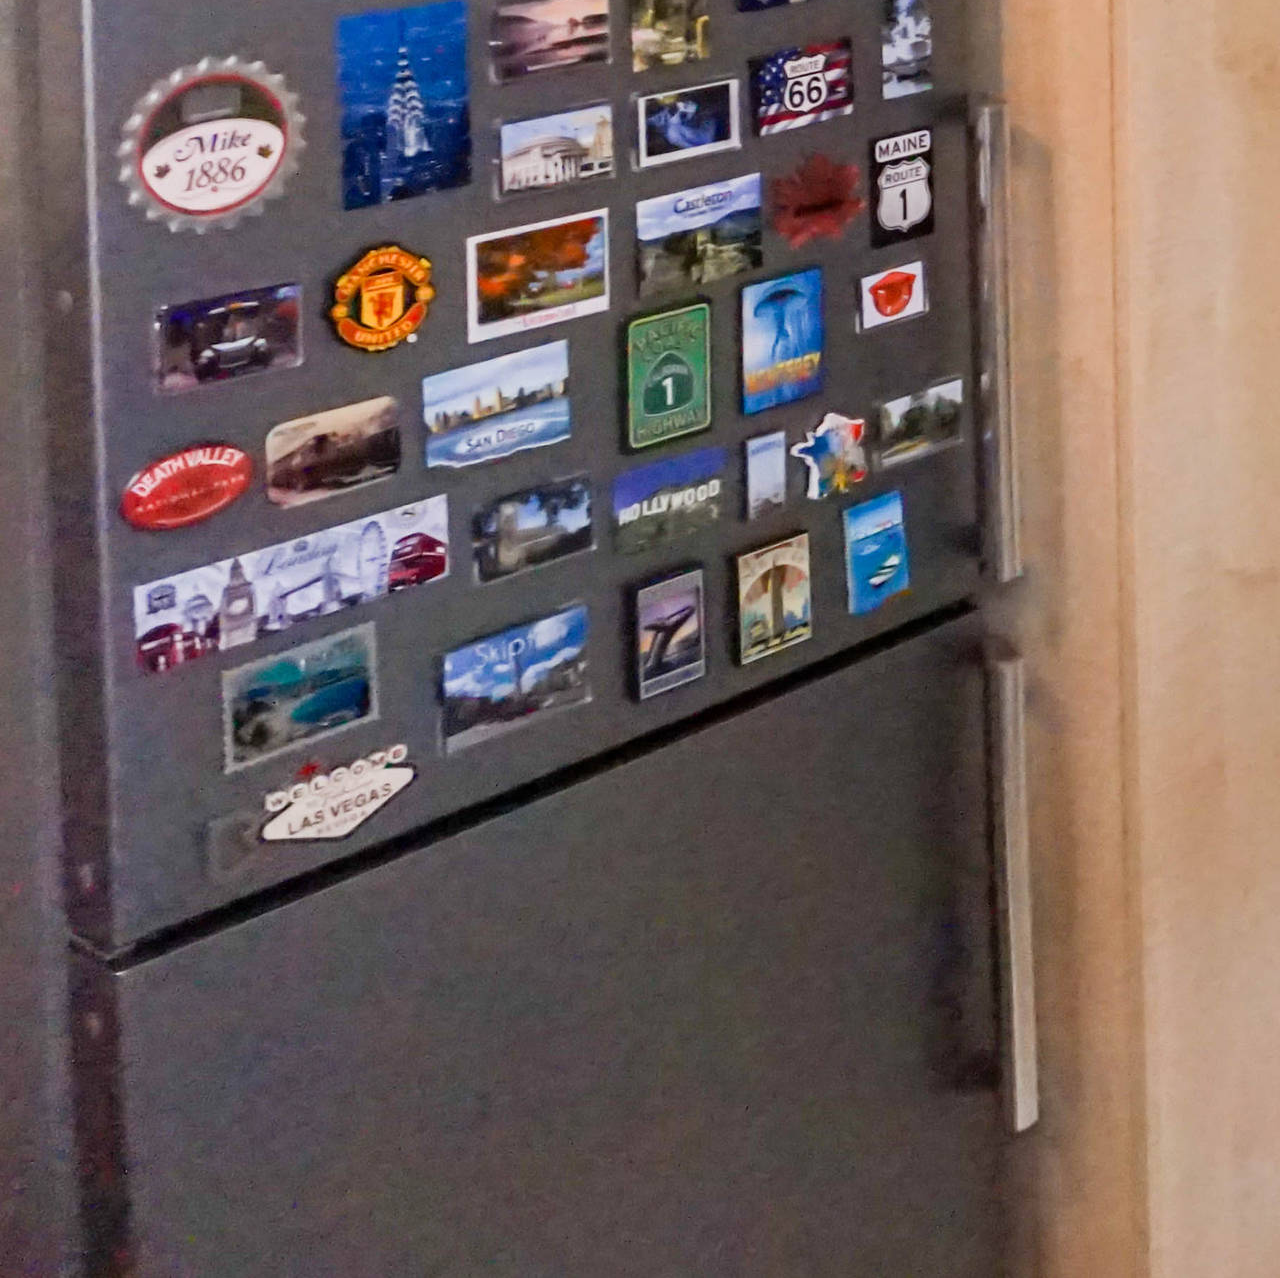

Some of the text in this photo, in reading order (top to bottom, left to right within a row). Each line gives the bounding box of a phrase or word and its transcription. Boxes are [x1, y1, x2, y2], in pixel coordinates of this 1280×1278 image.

[790, 59, 821, 73] ROUTE
[788, 76, 823, 109] 66
[174, 130, 252, 163] Mike
[879, 133, 929, 159] MAINE
[184, 155, 248, 192] 1886
[885, 166, 923, 184] ROUTE
[899, 188, 909, 221] 1
[660, 377, 675, 406] 1
[466, 435, 493, 453] SAN
[131, 447, 246, 498] DEATH VALLEY
[618, 479, 721, 526] HOLLYWOOD
[270, 748, 404, 808] WELCOME
[288, 810, 326, 836] LAS
[330, 782, 393, 818] VEGAS
